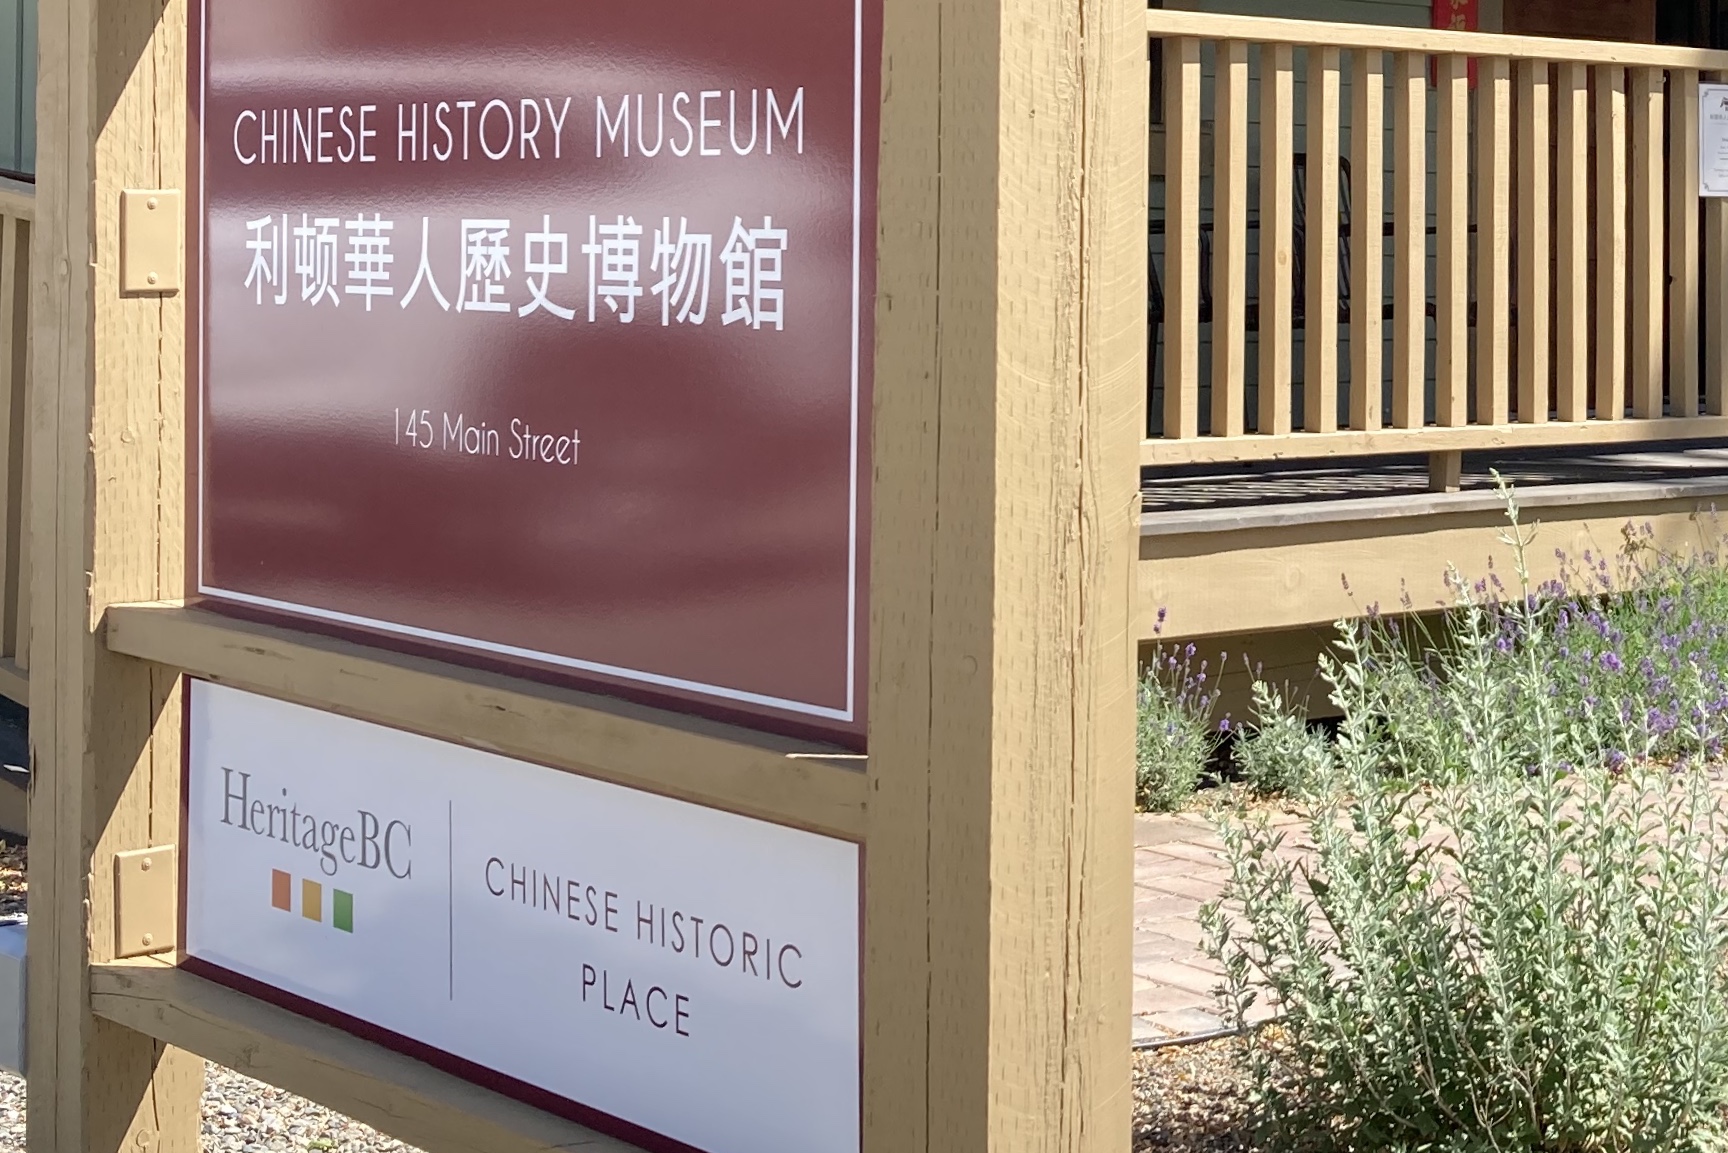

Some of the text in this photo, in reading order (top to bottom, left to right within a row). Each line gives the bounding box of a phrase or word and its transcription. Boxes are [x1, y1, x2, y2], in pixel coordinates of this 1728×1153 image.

[233, 86, 806, 165] CHINESE HISTORY MUSEUM
[243, 212, 789, 331] 利顿華人歷史博物館
[393, 407, 582, 466] 145 Main Street
[219, 766, 413, 879] HeritageBC
[484, 856, 804, 989] CHINESE HISTORIC
[581, 963, 692, 1038] PLACE
